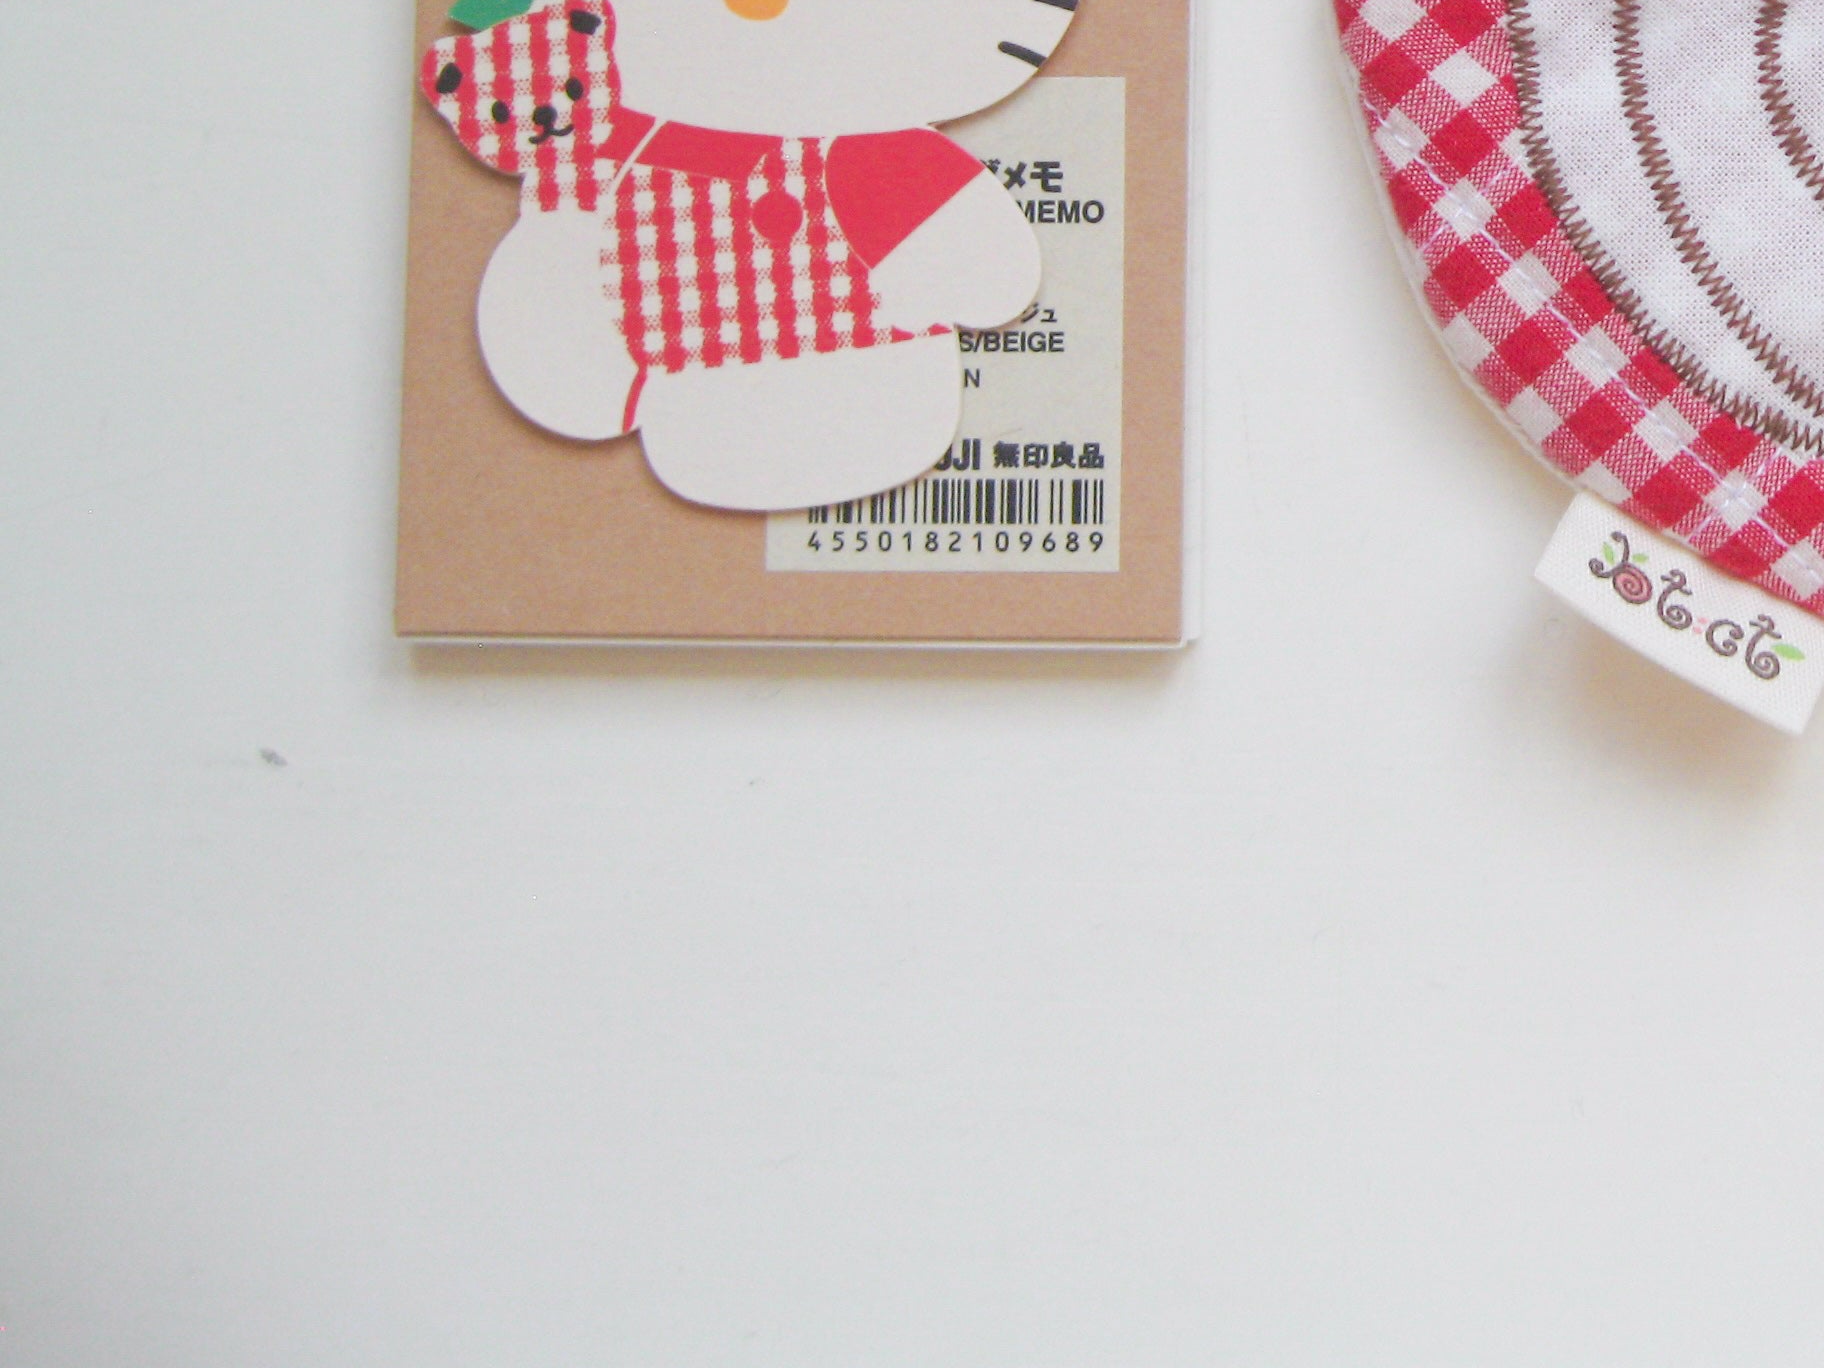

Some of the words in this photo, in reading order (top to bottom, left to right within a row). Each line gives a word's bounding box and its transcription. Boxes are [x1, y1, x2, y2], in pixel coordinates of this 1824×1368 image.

[993, 440, 1105, 470] 無印良品
[807, 531, 1104, 554] 4550182109689
